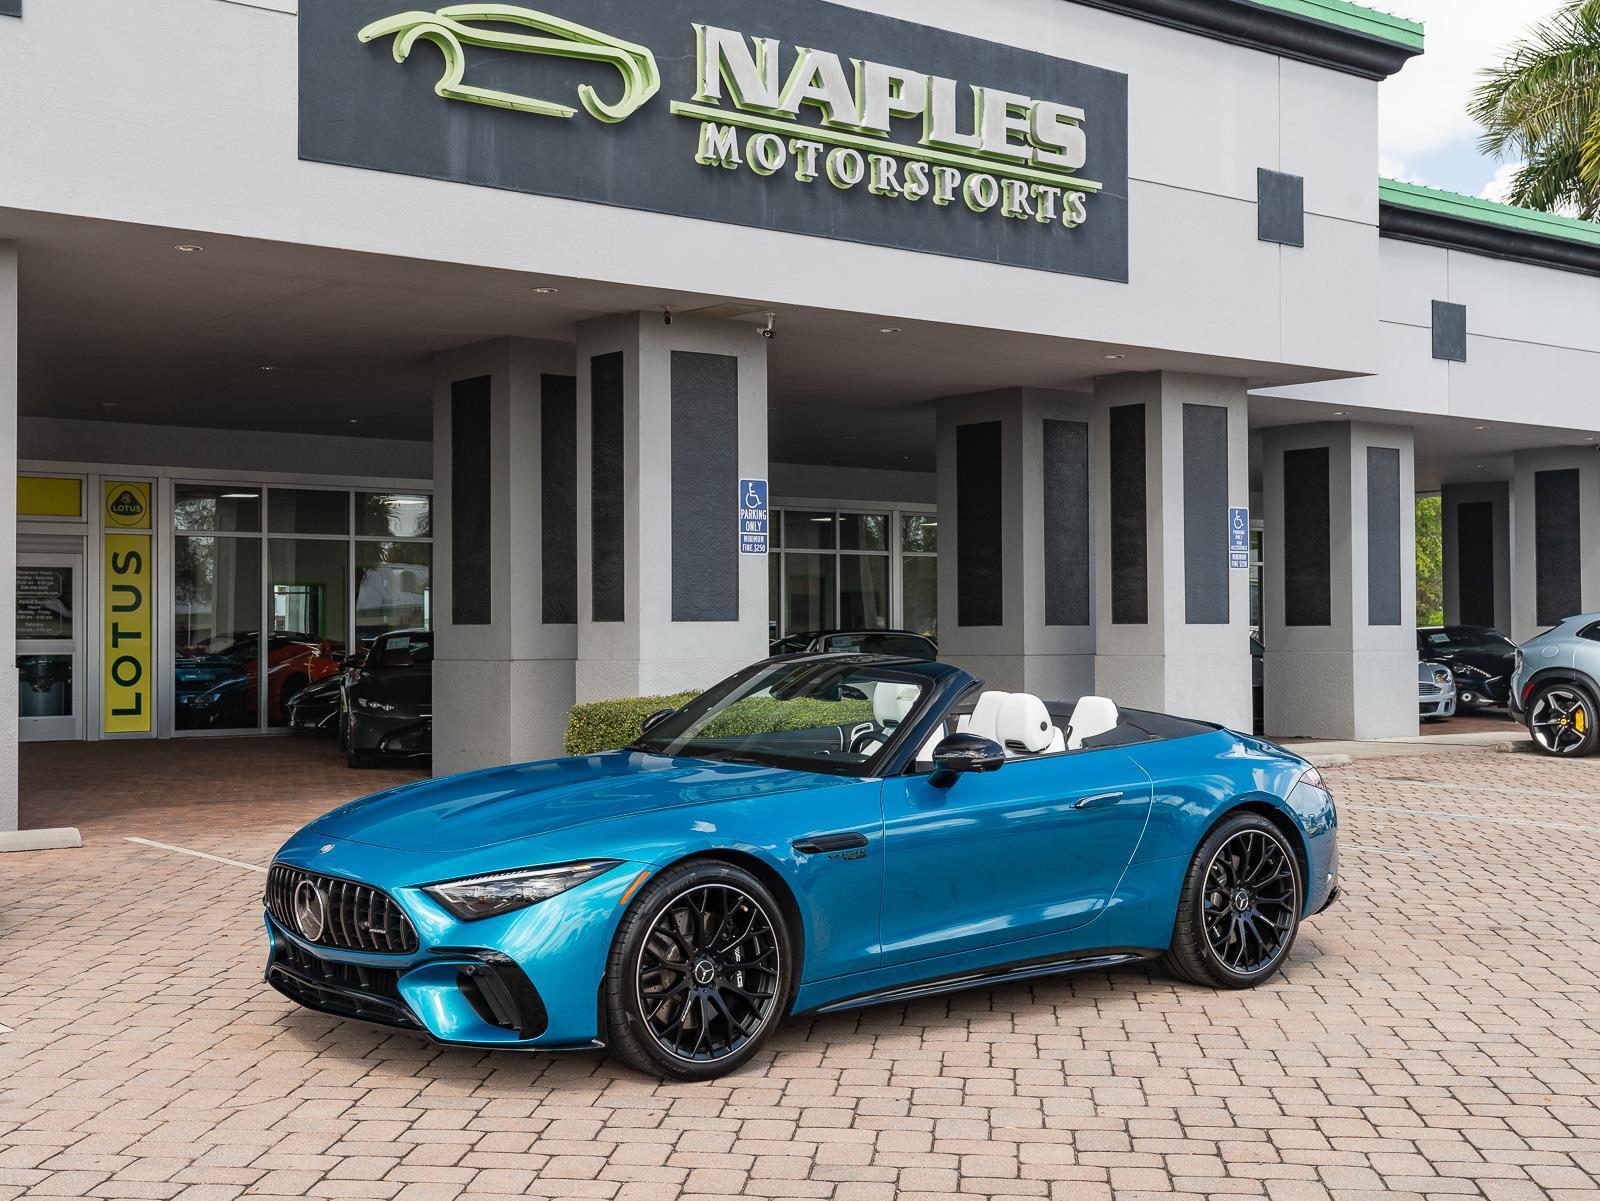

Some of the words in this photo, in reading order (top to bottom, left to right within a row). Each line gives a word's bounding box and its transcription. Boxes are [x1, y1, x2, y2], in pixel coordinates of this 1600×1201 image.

[691, 22, 1086, 173] NAPLES
[695, 122, 1086, 229] MOTORSPORTS
[113, 504, 142, 512] LOTUS
[740, 509, 767, 520] PARKING
[745, 521, 762, 531] ONLY
[111, 551, 143, 716] LOTUS
